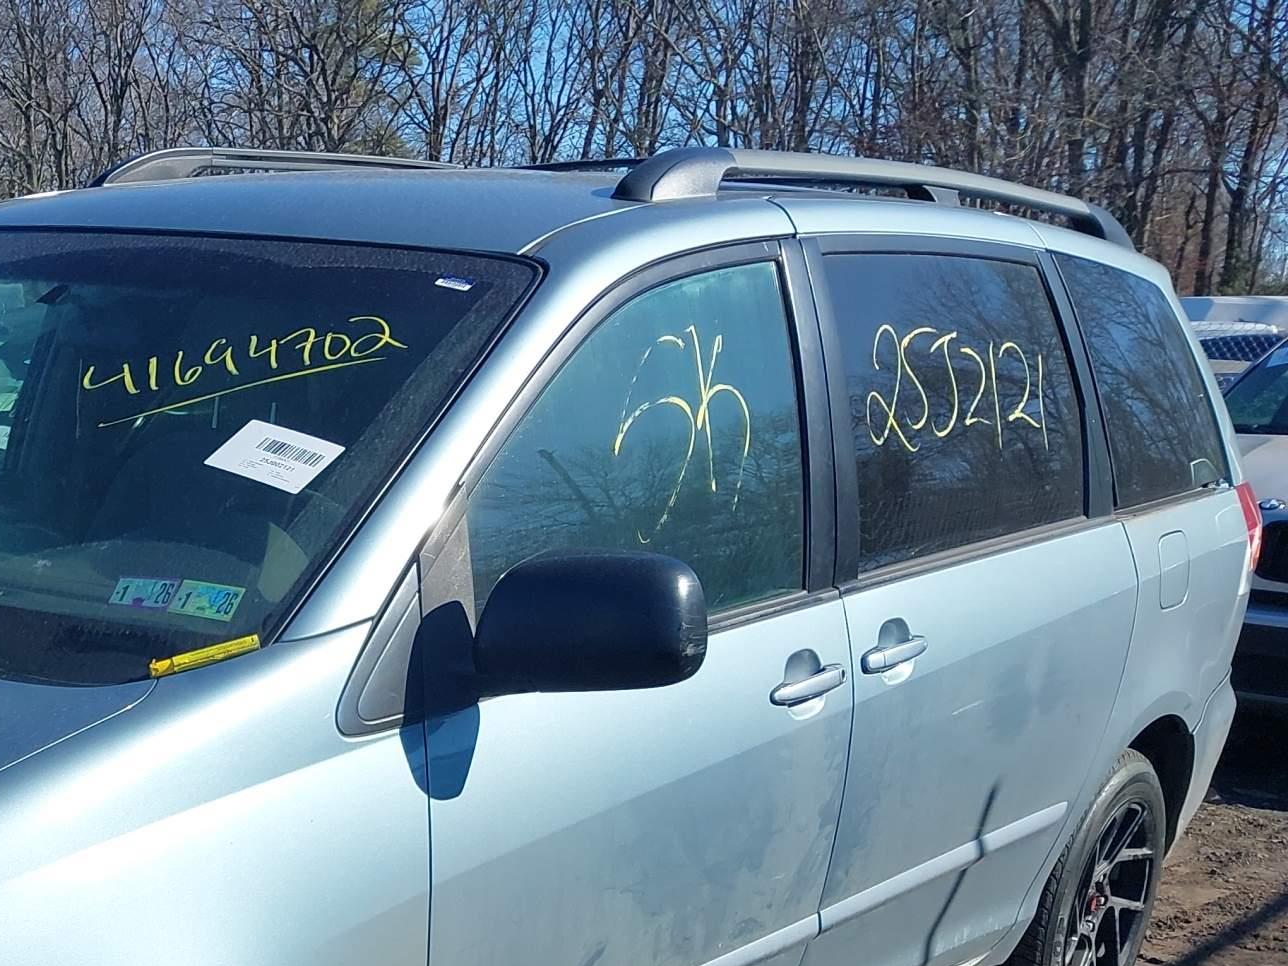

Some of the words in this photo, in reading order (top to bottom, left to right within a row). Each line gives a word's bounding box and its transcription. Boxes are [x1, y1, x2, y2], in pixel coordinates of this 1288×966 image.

[82, 316, 409, 394] 41694702
[154, 582, 175, 604] 26
[216, 591, 239, 615] 26
